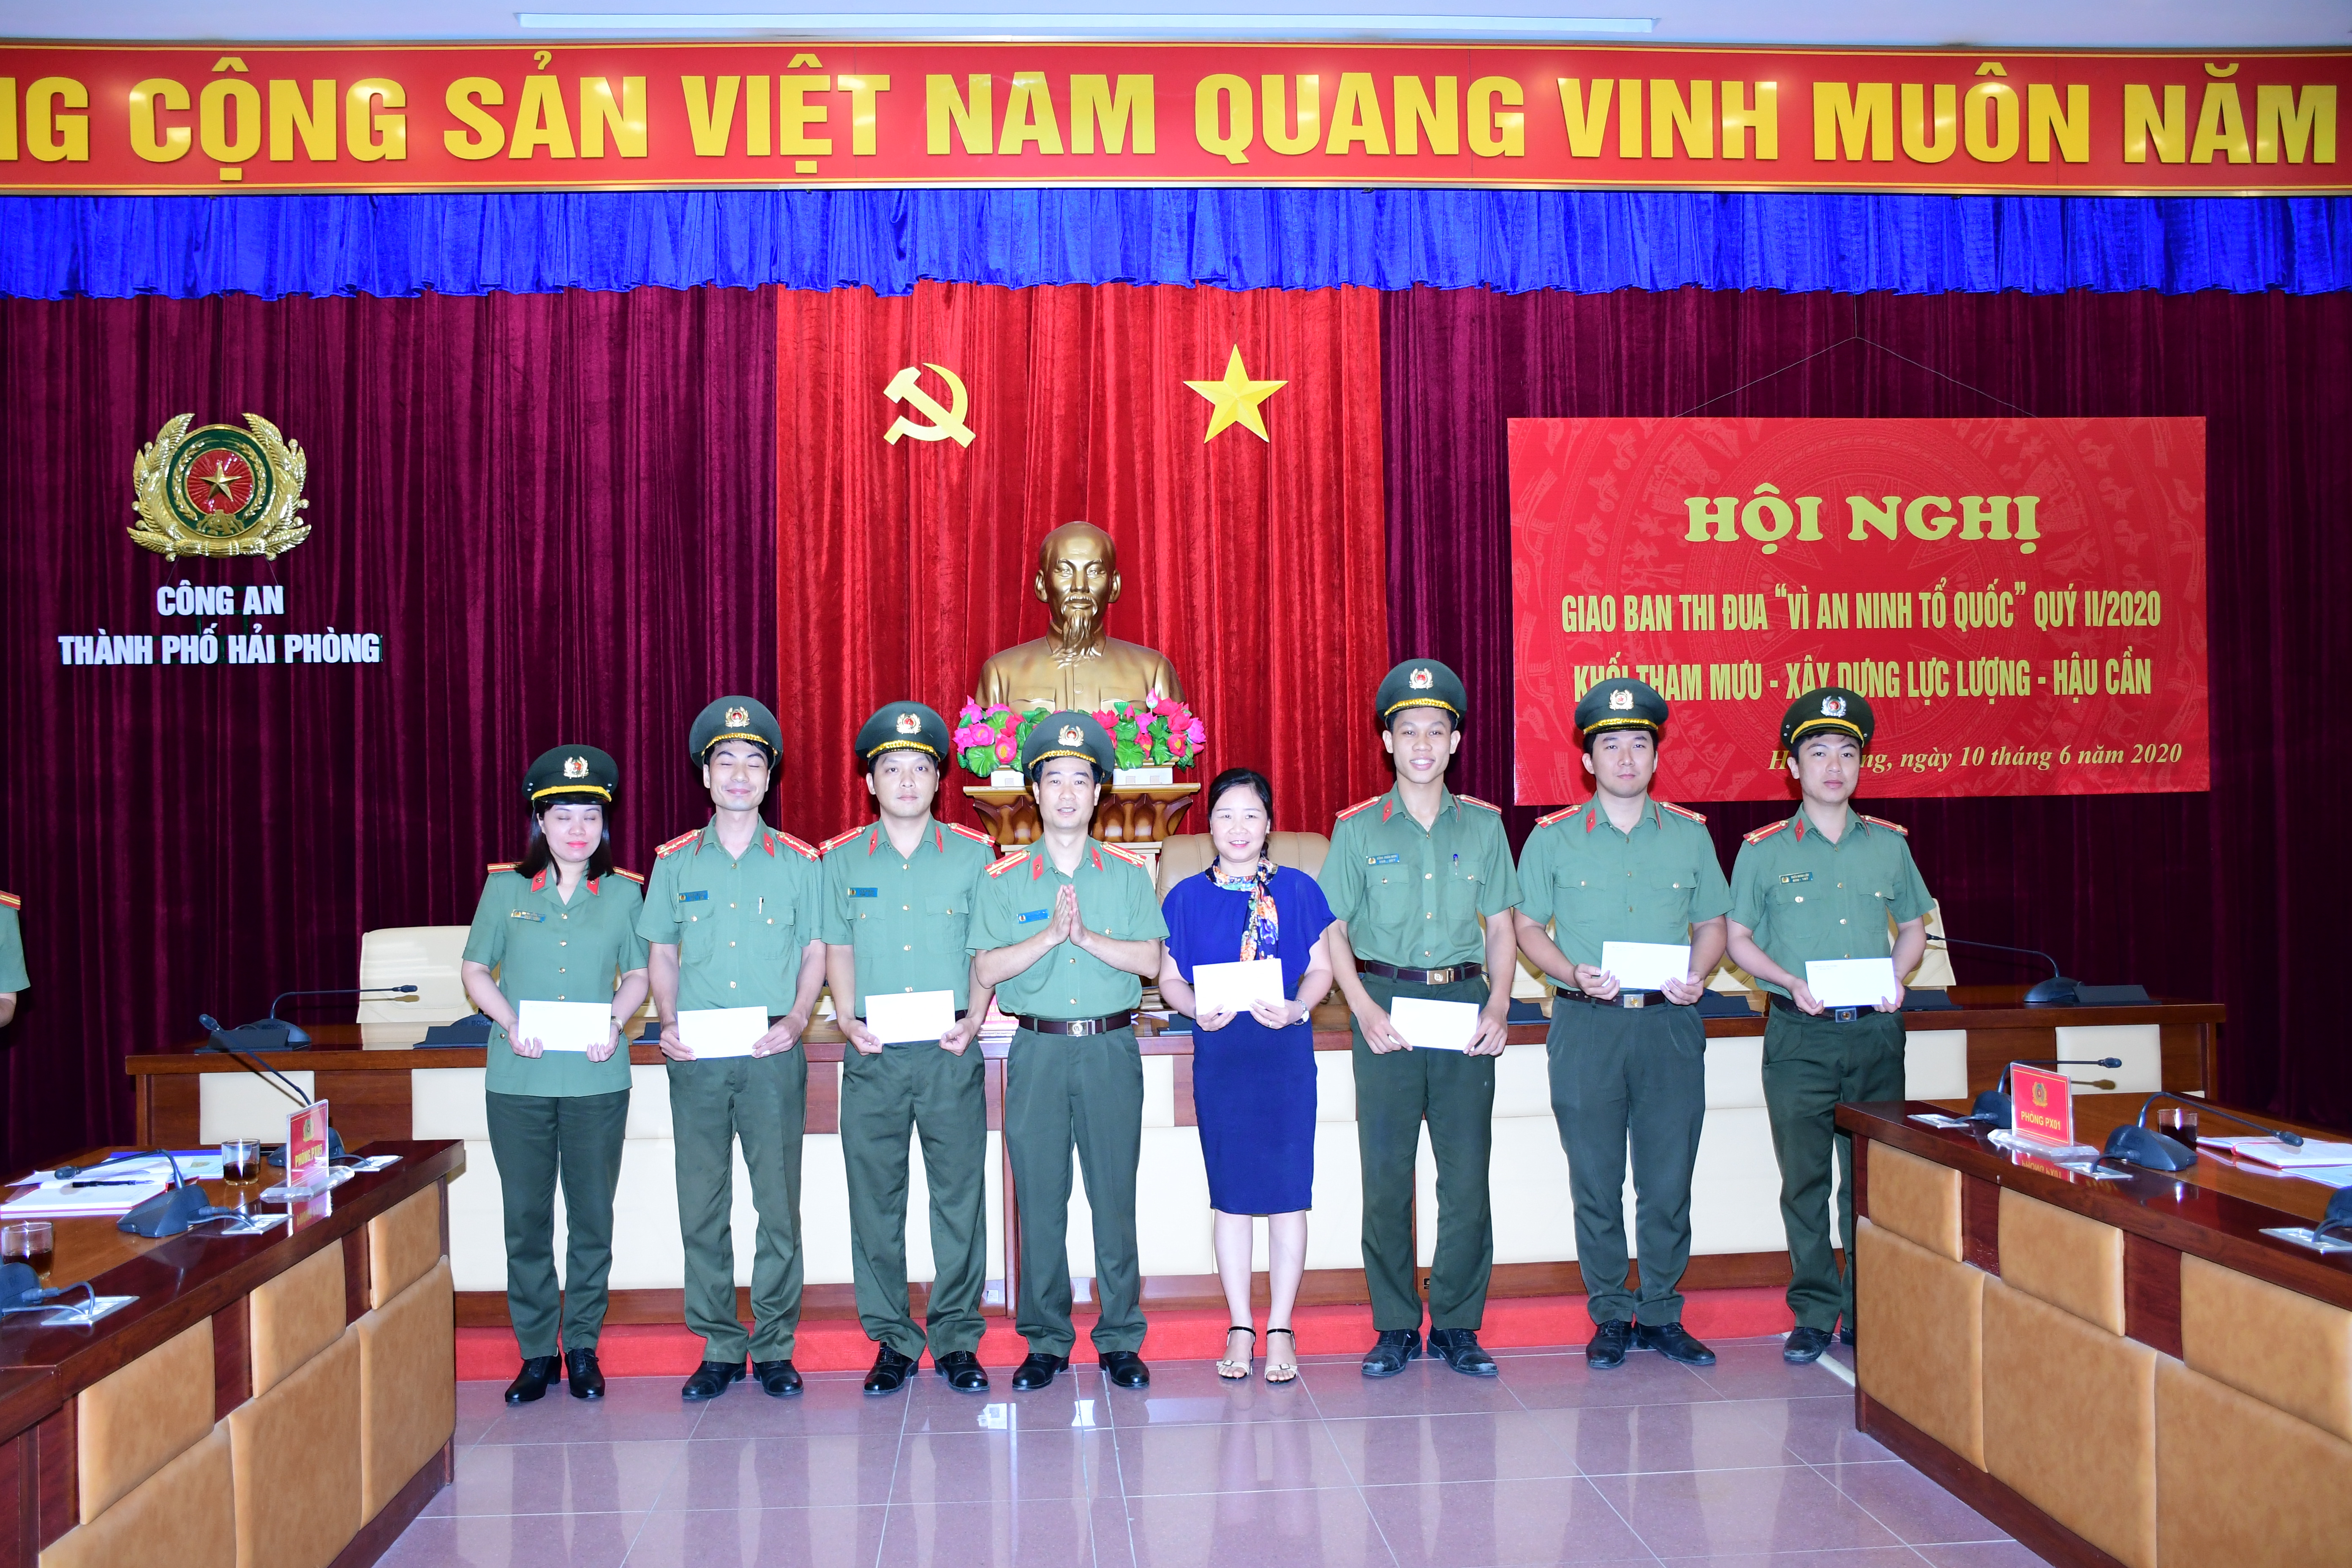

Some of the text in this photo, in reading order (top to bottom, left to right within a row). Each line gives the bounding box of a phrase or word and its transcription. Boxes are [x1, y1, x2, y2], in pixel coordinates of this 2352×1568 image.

[0, 50, 2337, 181] G CỘNG SẢN VIỆT NAM QUANG VINH MUÔN NĂM
[1684, 482, 2041, 555] HỘI NGHỊ
[157, 579, 284, 616] CÔNG AN
[1562, 594, 1617, 633] GIAO
[1624, 594, 1673, 632] BAN
[1679, 594, 1715, 631] THI
[1722, 593, 1769, 631] ĐUA
[1817, 592, 1849, 629] AN
[1856, 592, 1913, 629] NINH
[1918, 577, 1947, 629] TỔ
[2034, 583, 2077, 632] QUÝ
[2084, 590, 2161, 627] II/2020
[57, 622, 380, 665] THÀNH PHỐ HẢI PHÒNG
[1710, 659, 1762, 701] MƯU
[1786, 654, 1831, 700] XÂY
[1907, 657, 1949, 706] LỰC
[1957, 656, 2031, 705] LƯỢNG
[2053, 651, 2098, 704] HẬU
[2105, 645, 2151, 695] CẦN
[1900, 747, 1952, 773] ngày
[1959, 746, 1985, 767] 10
[1990, 746, 2053, 770] tháng
[2059, 745, 2072, 765] 6
[2077, 746, 2124, 764] năm
[2132, 743, 2183, 763] 2020
[2021, 1111, 2061, 1130] PHÒNG PX01
[295, 1149, 311, 1168] PHÒNG
